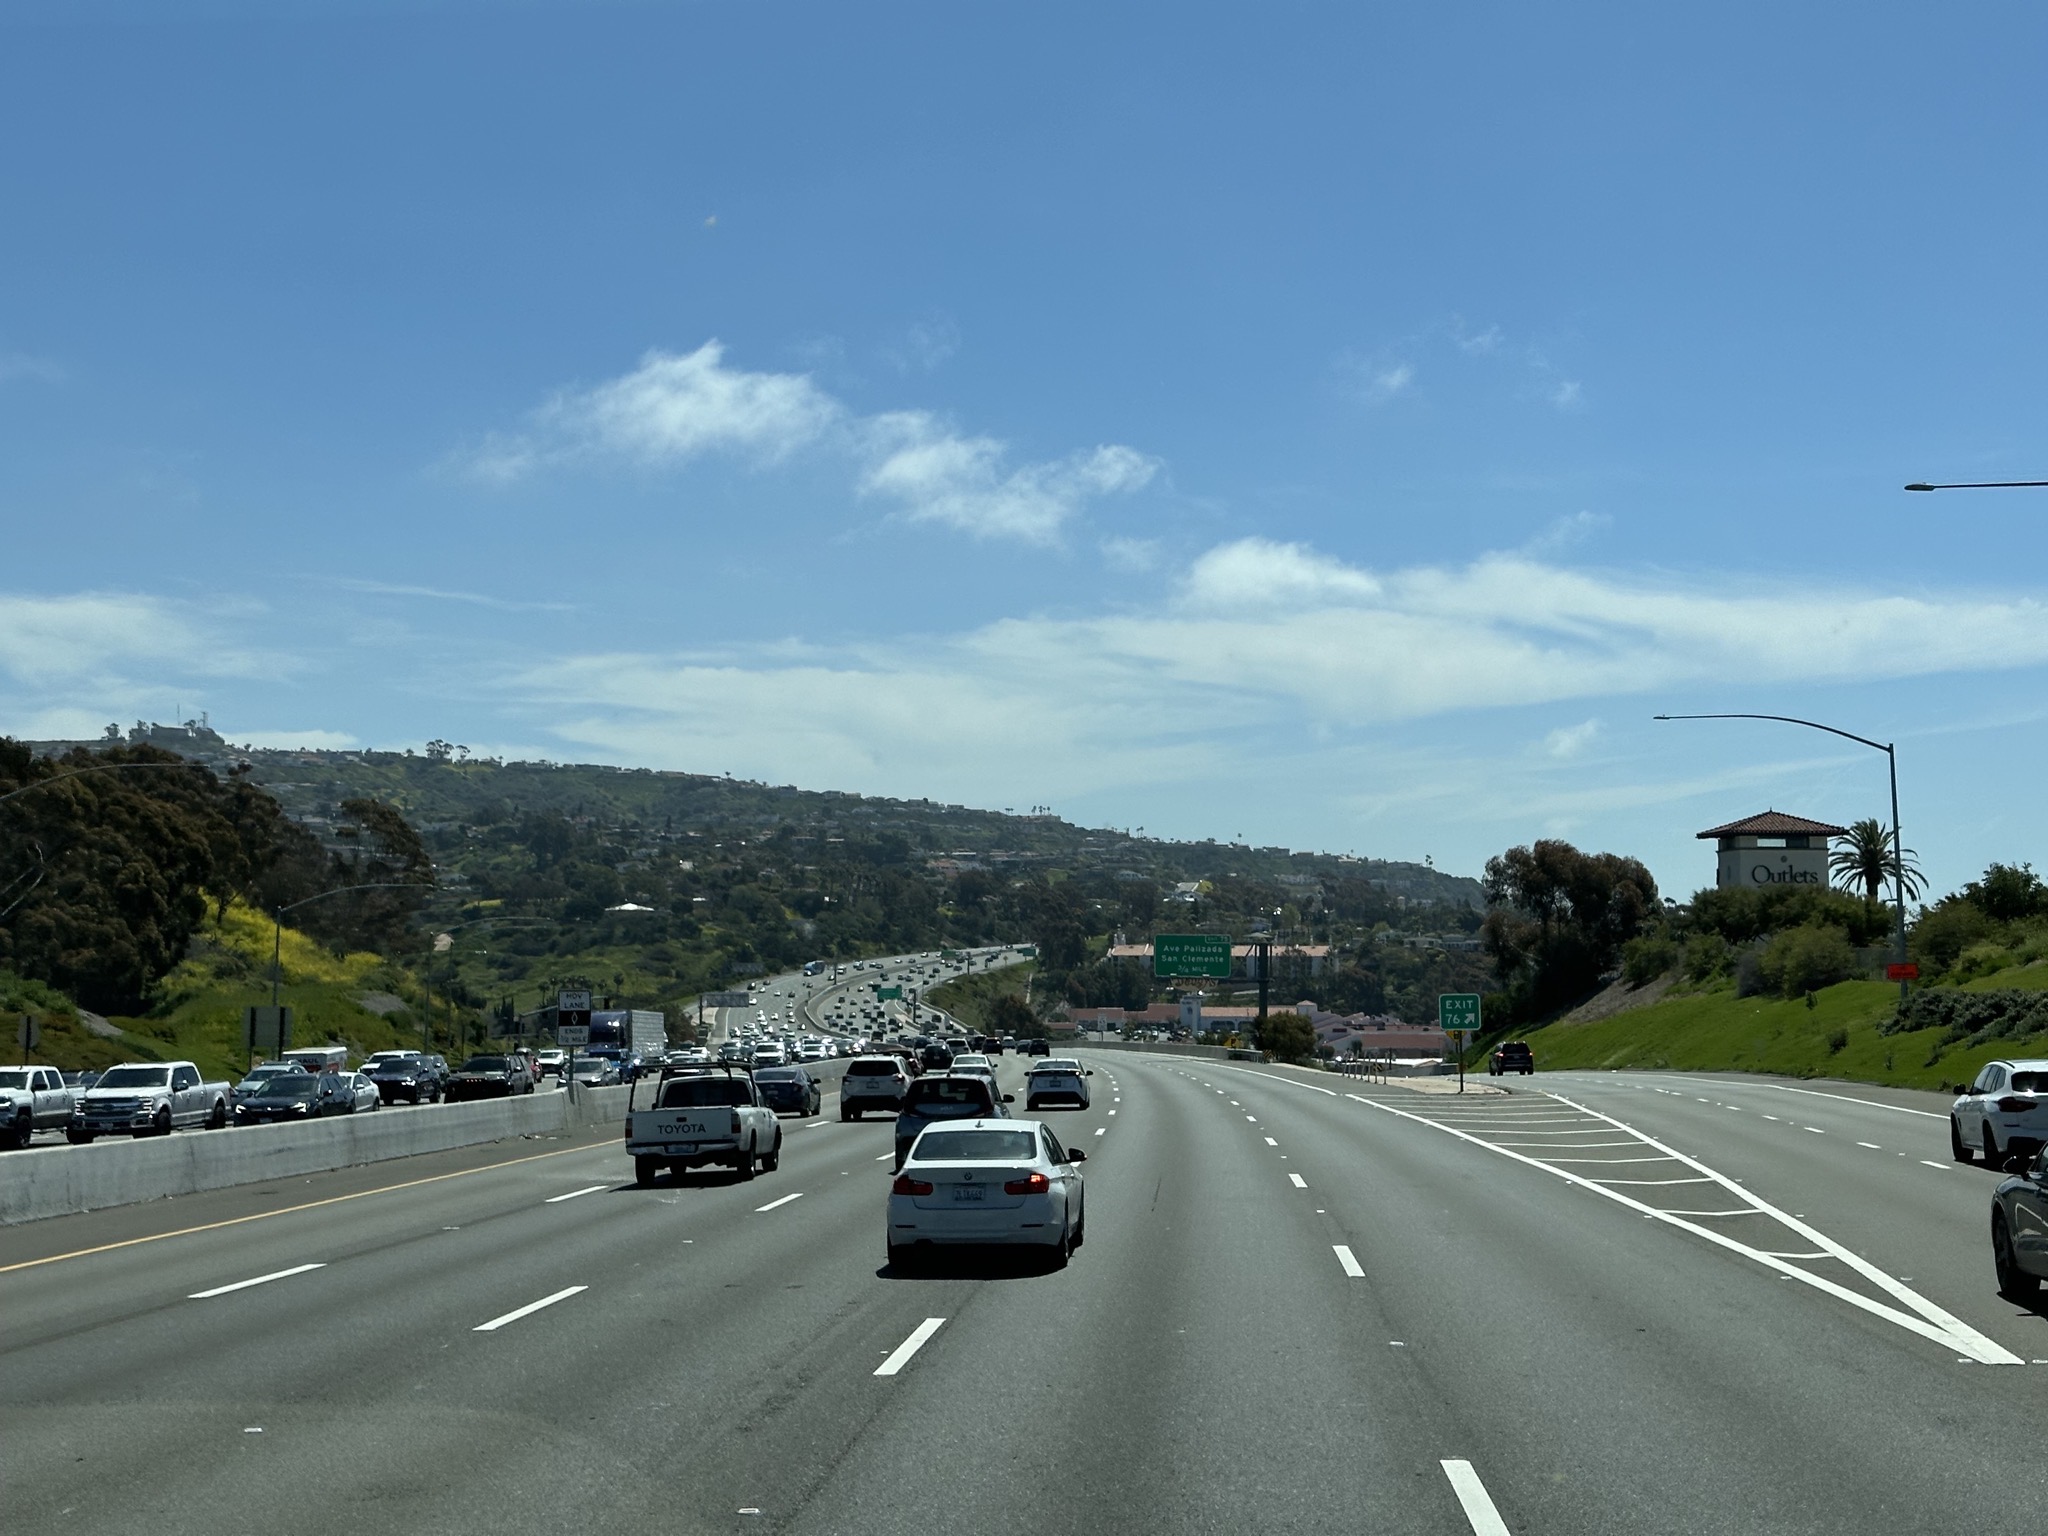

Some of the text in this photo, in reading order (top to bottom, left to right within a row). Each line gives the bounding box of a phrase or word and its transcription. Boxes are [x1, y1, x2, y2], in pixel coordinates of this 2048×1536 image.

[1751, 864, 1818, 884] Outlets
[1184, 945, 1223, 953] Palizada
[1182, 955, 1224, 963] Clemente
[1445, 1000, 1473, 1009] EXIT
[1445, 1013, 1460, 1024] 76
[657, 1123, 706, 1134] TOYOTA
